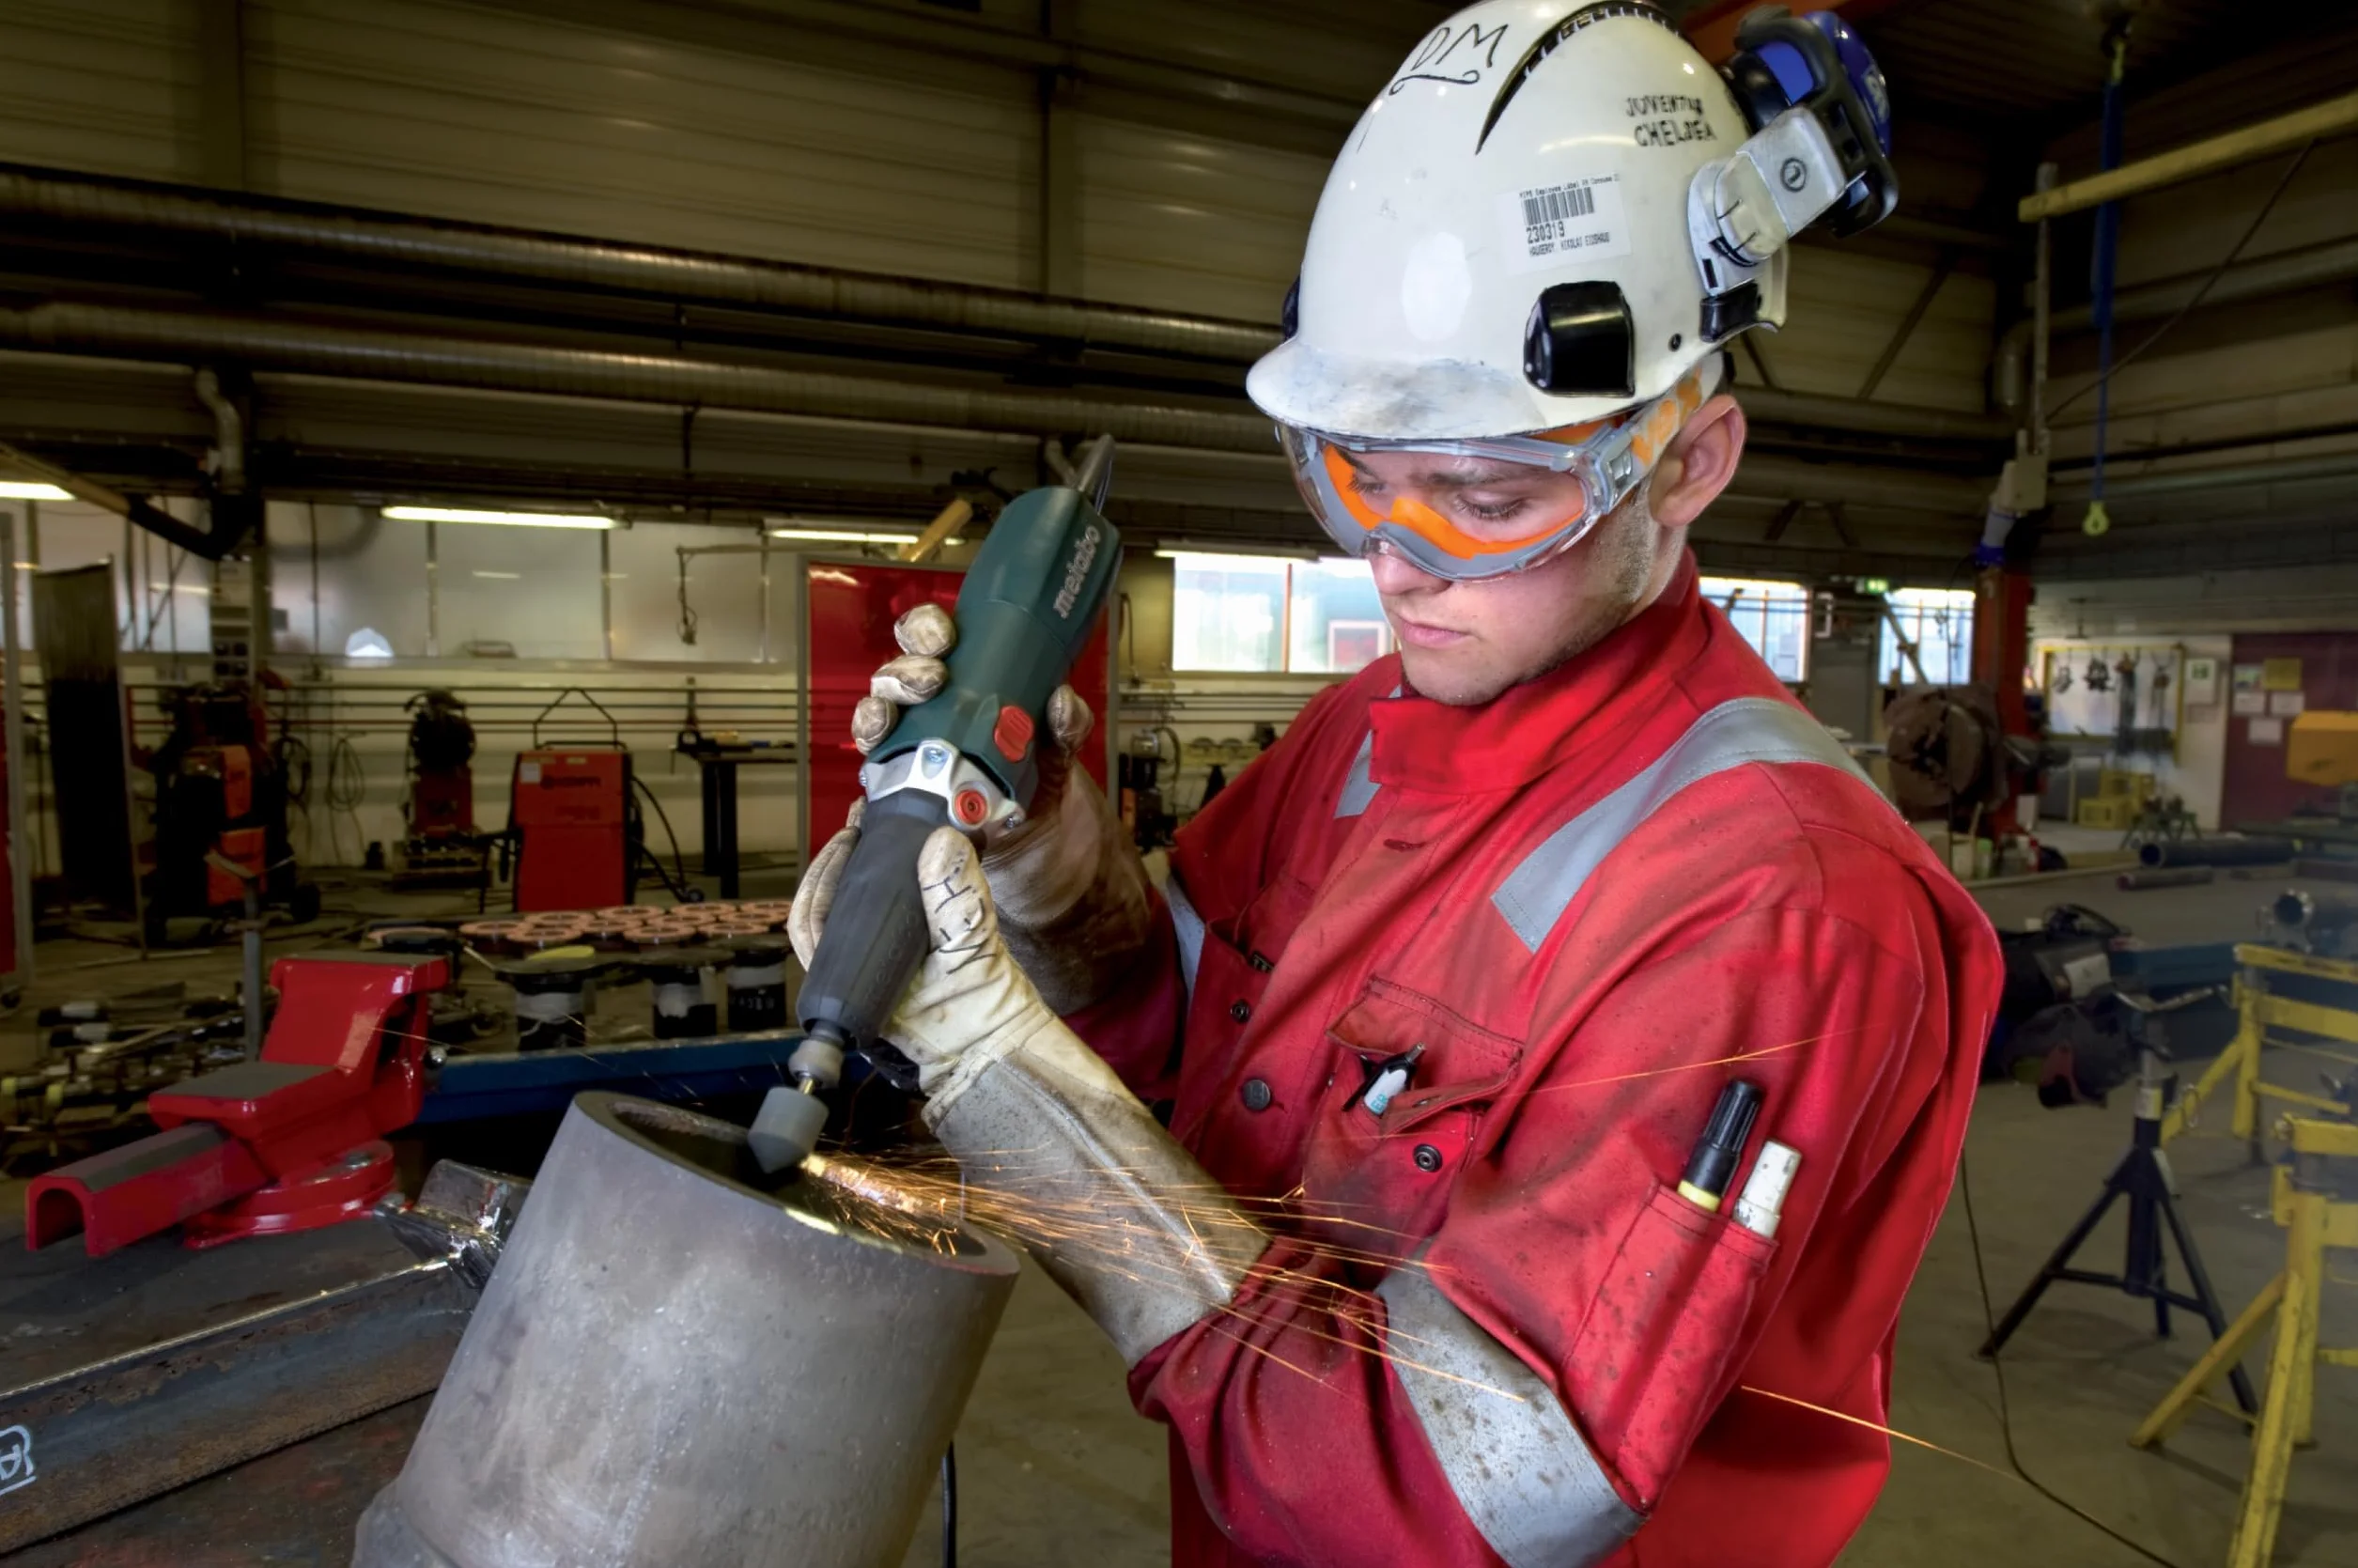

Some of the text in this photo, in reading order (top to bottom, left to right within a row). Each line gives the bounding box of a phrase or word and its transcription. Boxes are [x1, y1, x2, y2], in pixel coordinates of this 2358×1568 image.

[1635, 119, 1718, 147] CHELSEA
[1526, 221, 1565, 244] 230319
[1053, 525, 1101, 619] metabo
